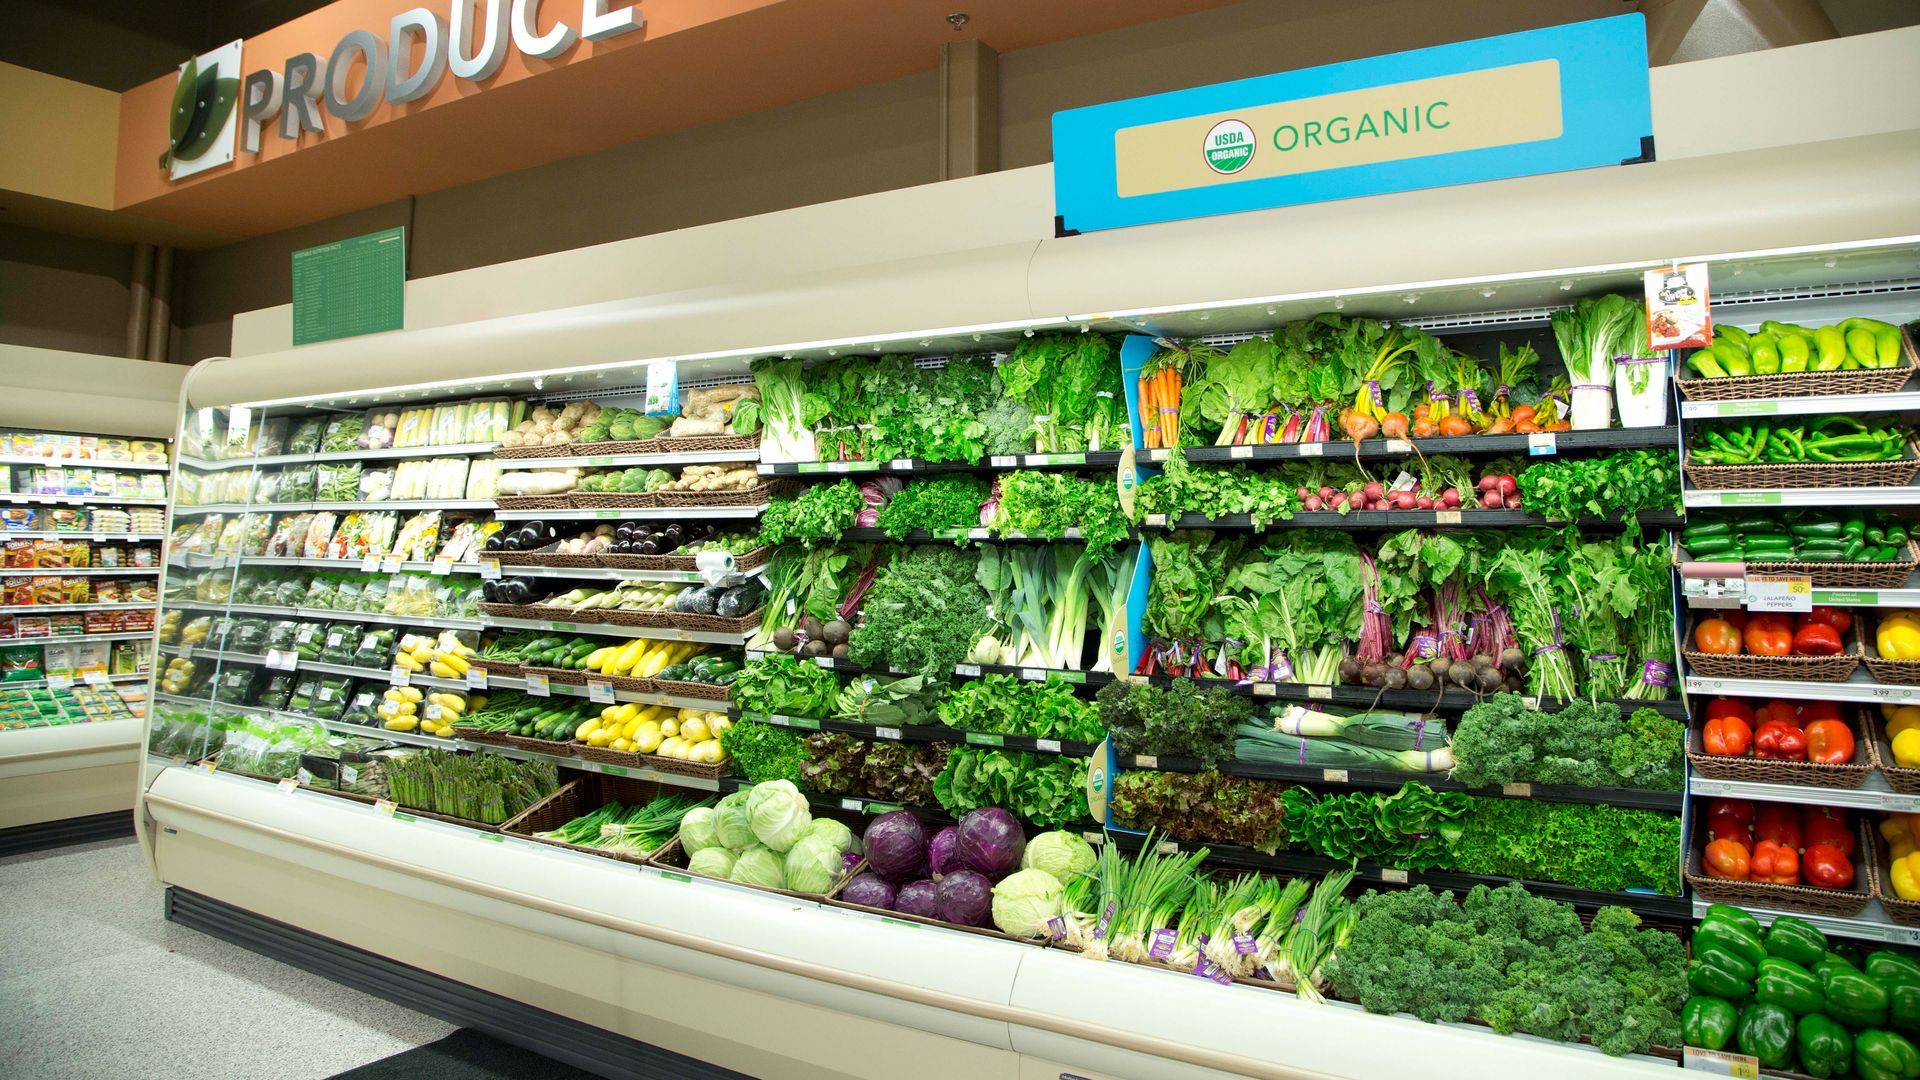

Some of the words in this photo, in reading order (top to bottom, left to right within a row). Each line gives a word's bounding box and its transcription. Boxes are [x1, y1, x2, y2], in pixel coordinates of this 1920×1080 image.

[1273, 101, 1451, 152] ORGANIC
[1214, 131, 1245, 146] USDA
[1211, 147, 1249, 162] ORGANIC
